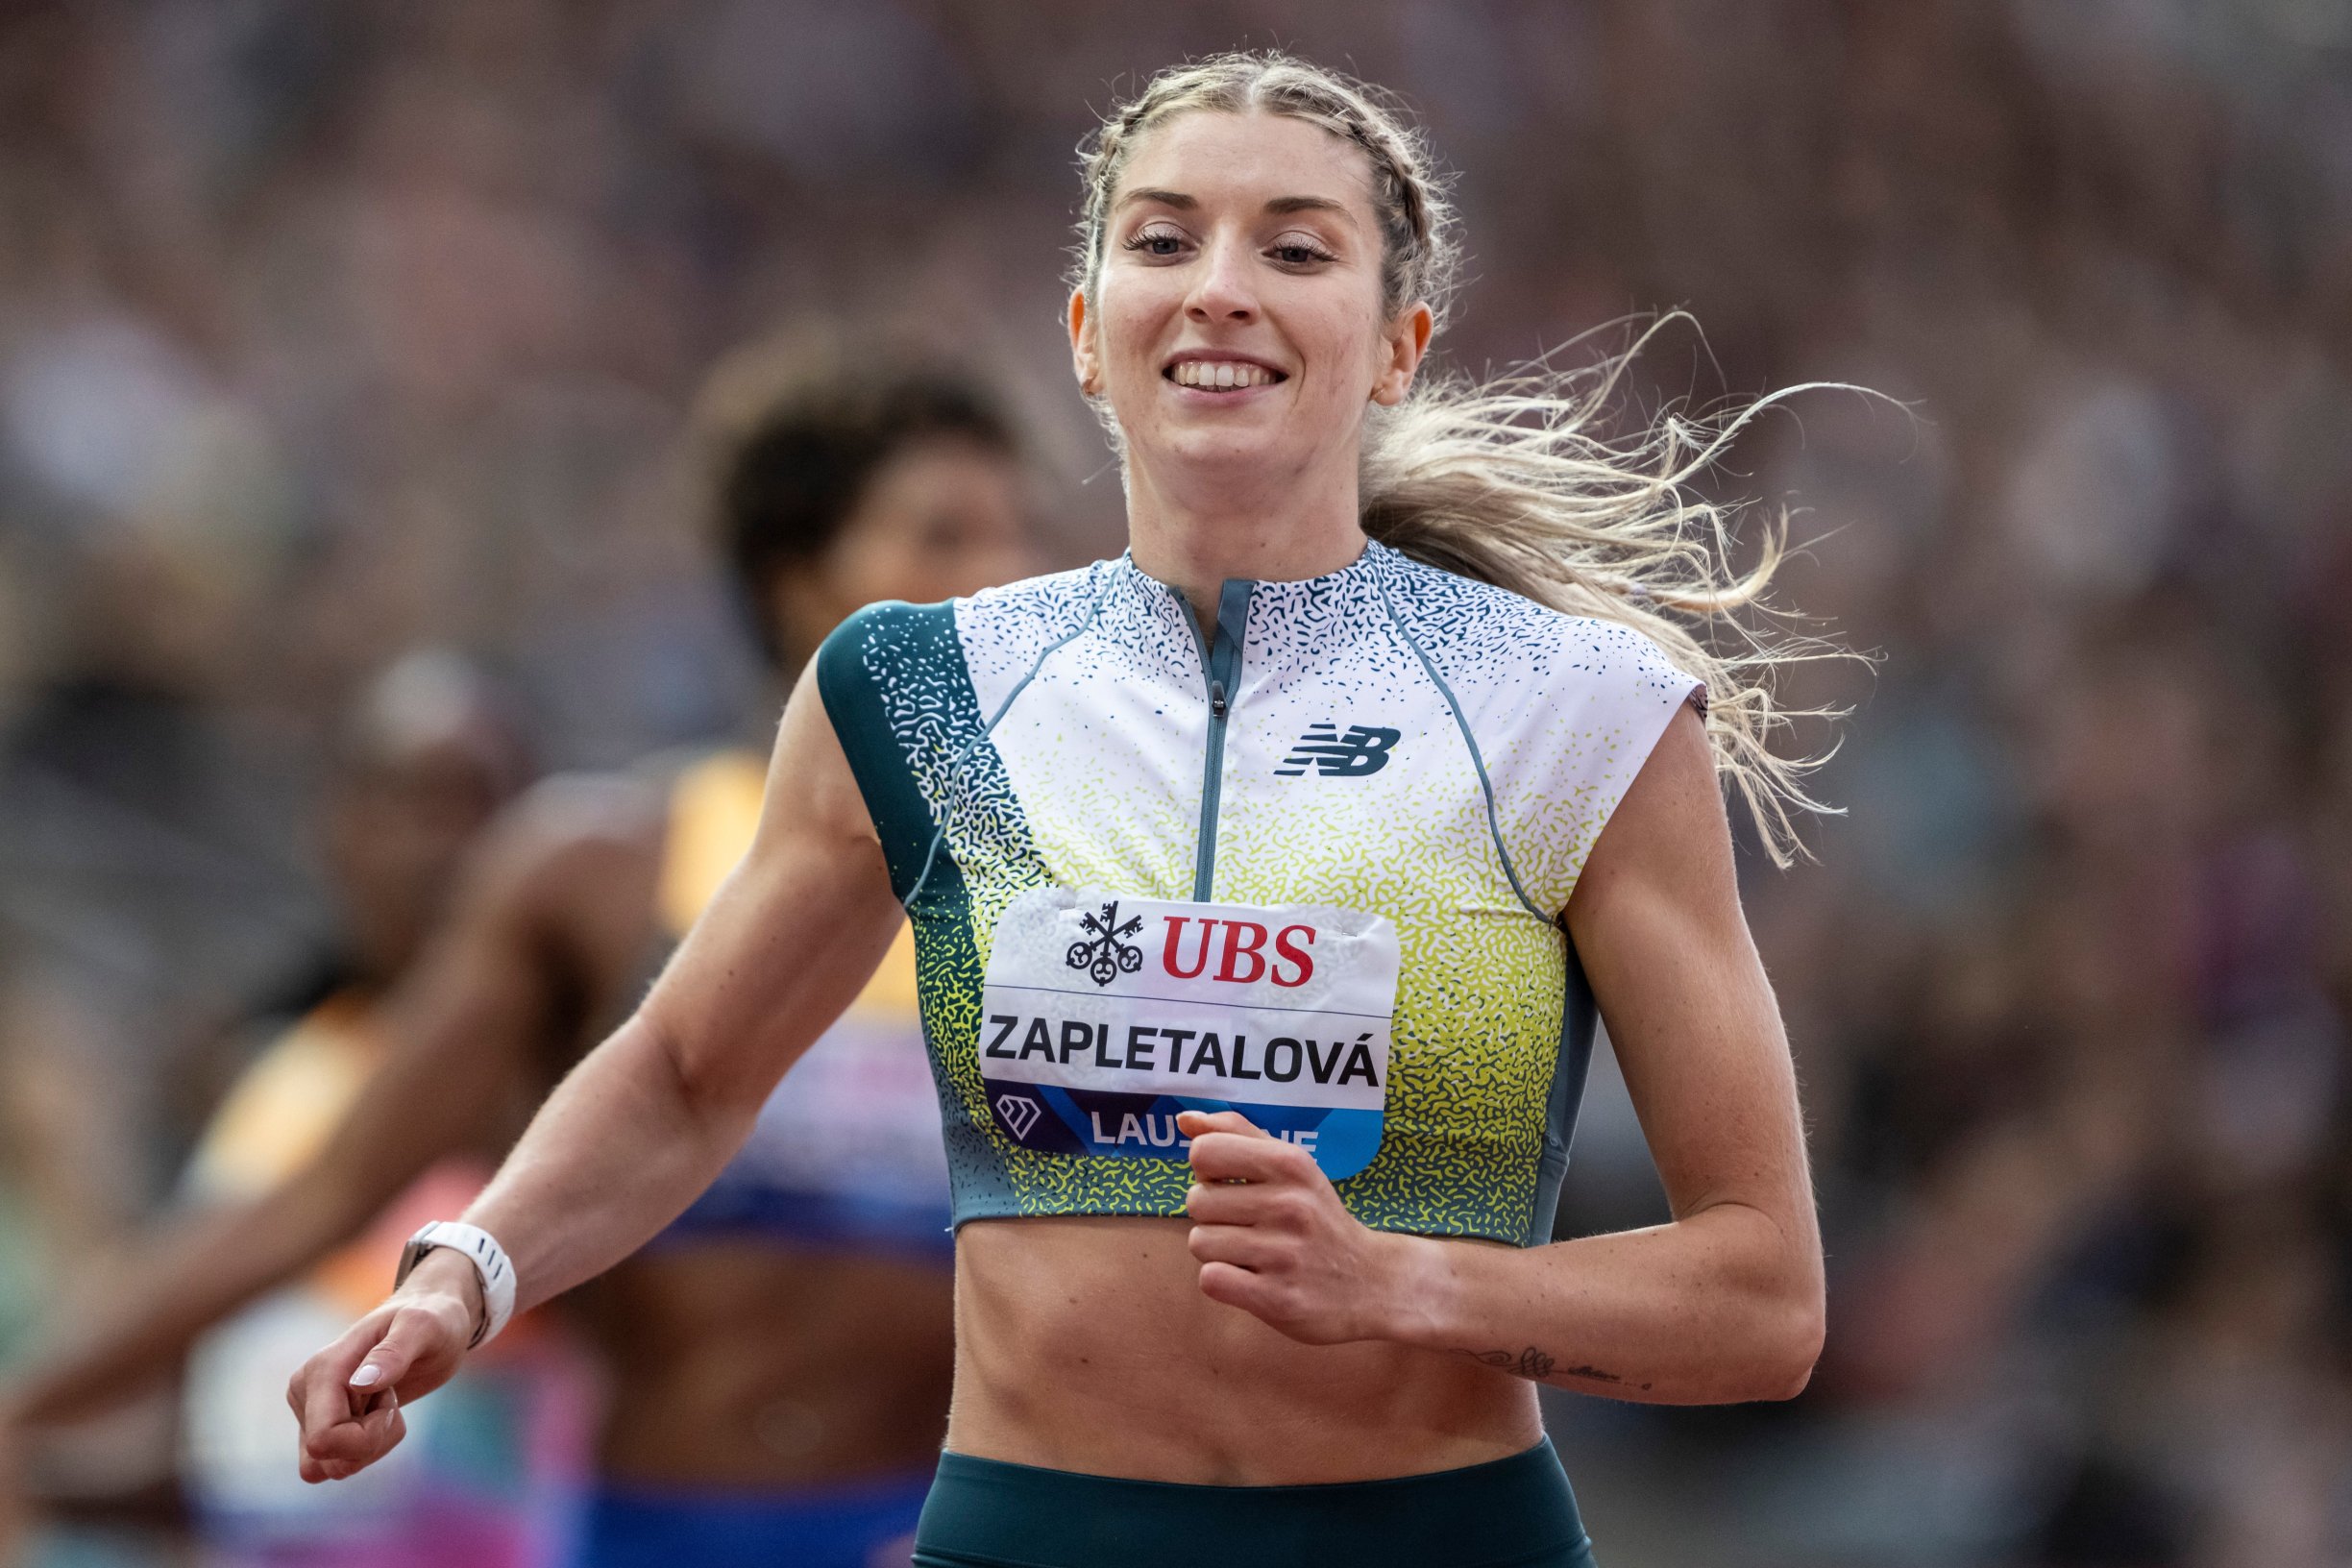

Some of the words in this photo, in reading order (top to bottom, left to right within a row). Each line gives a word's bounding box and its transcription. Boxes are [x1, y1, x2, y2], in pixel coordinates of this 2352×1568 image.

[1162, 916, 1316, 988] UBS
[986, 1015, 1379, 1088] ZAPLETALOVÁ
[1091, 1111, 1319, 1164] LAUE
